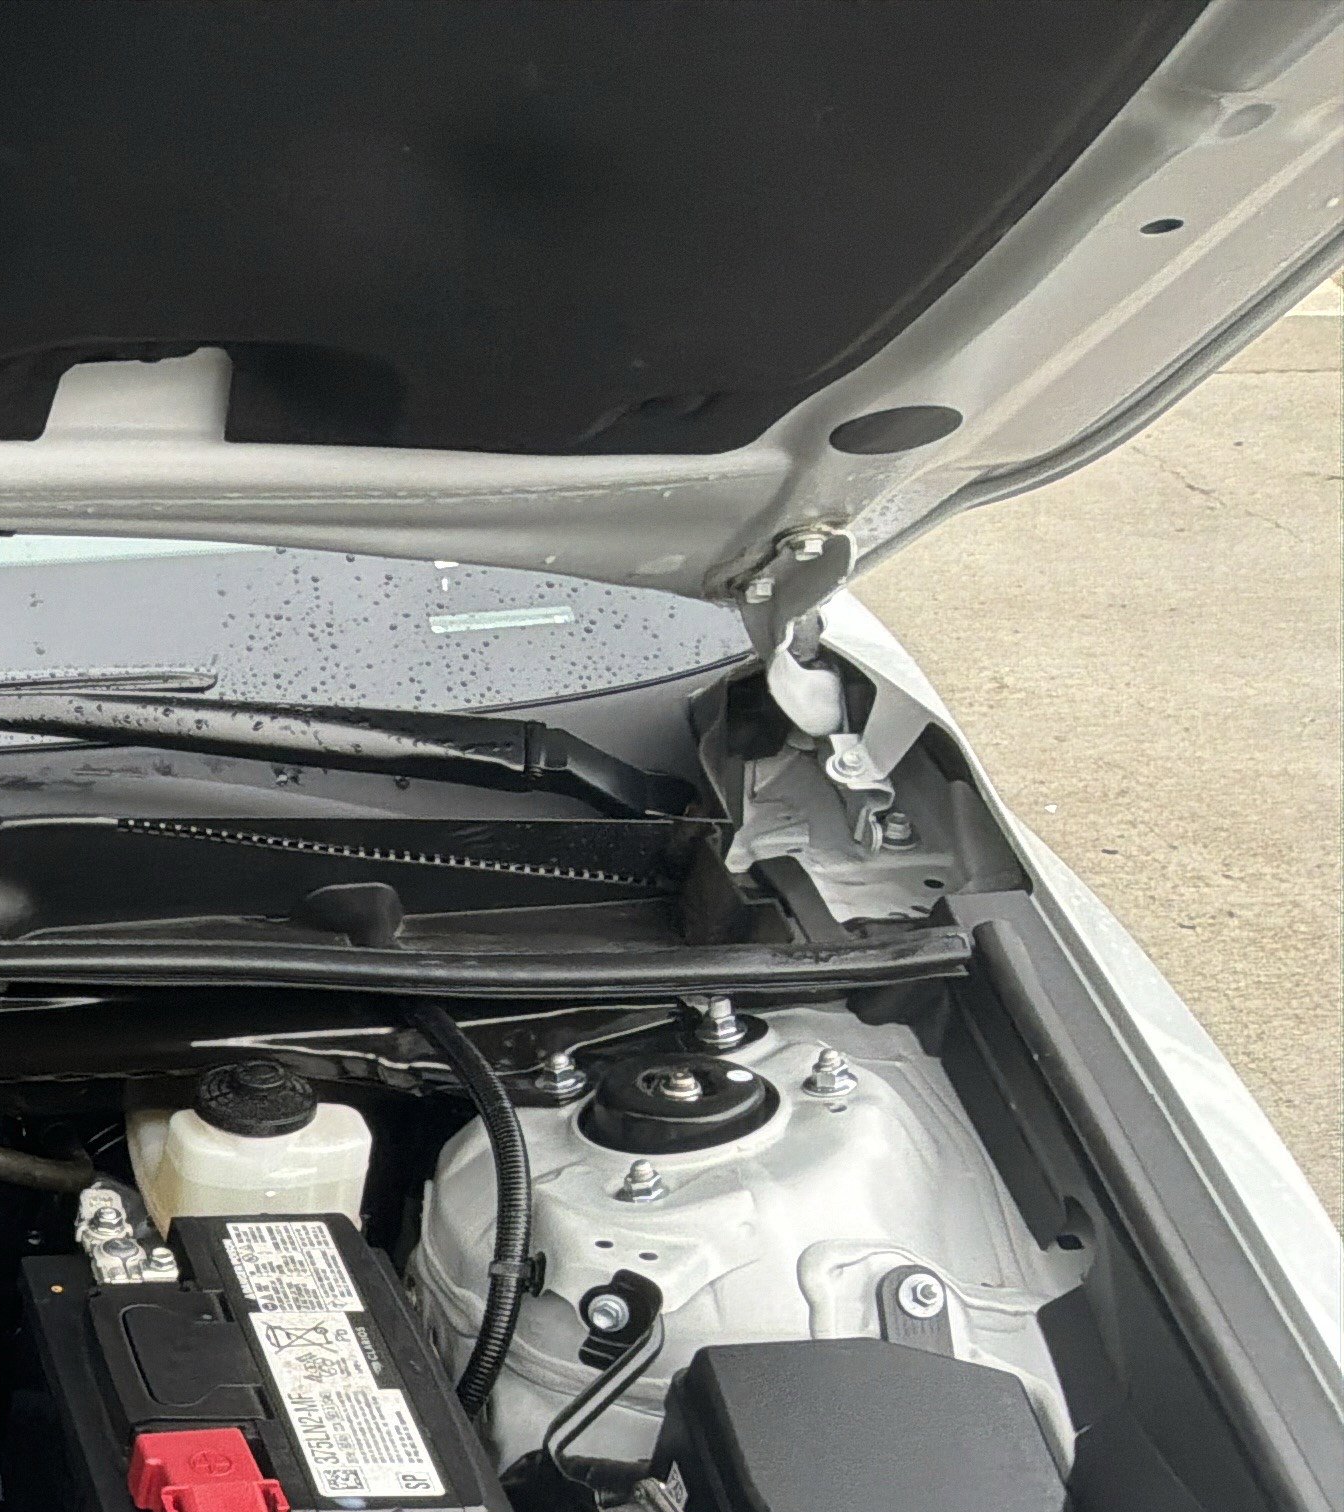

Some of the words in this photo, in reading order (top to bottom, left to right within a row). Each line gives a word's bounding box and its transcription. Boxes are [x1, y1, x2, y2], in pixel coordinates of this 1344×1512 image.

[355, 1326, 379, 1362] CLARIOS
[288, 1392, 340, 1465] 375LN2-MF
[402, 1474, 430, 1489] SP
